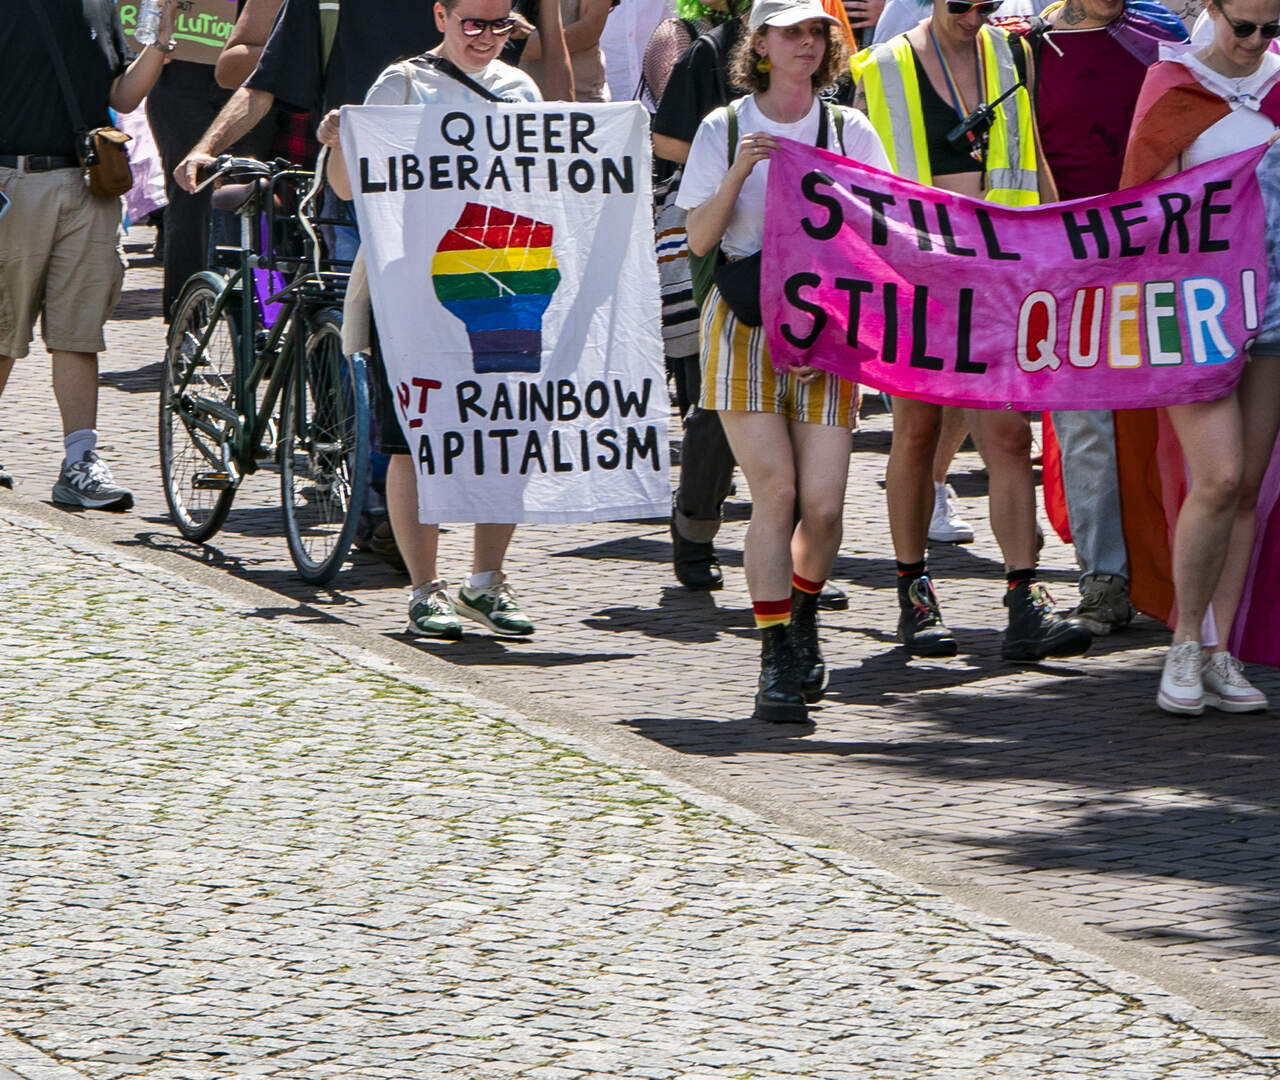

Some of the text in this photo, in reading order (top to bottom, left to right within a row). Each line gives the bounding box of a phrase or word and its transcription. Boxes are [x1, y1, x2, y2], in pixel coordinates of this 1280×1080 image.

[440, 111, 598, 154] QUEER
[359, 154, 635, 194] LIBERATION
[800, 169, 1234, 261] STILL HERE
[780, 268, 1259, 374] STILL QUEER!
[456, 378, 652, 423] RAINBOW
[419, 425, 661, 476] APITALISM
